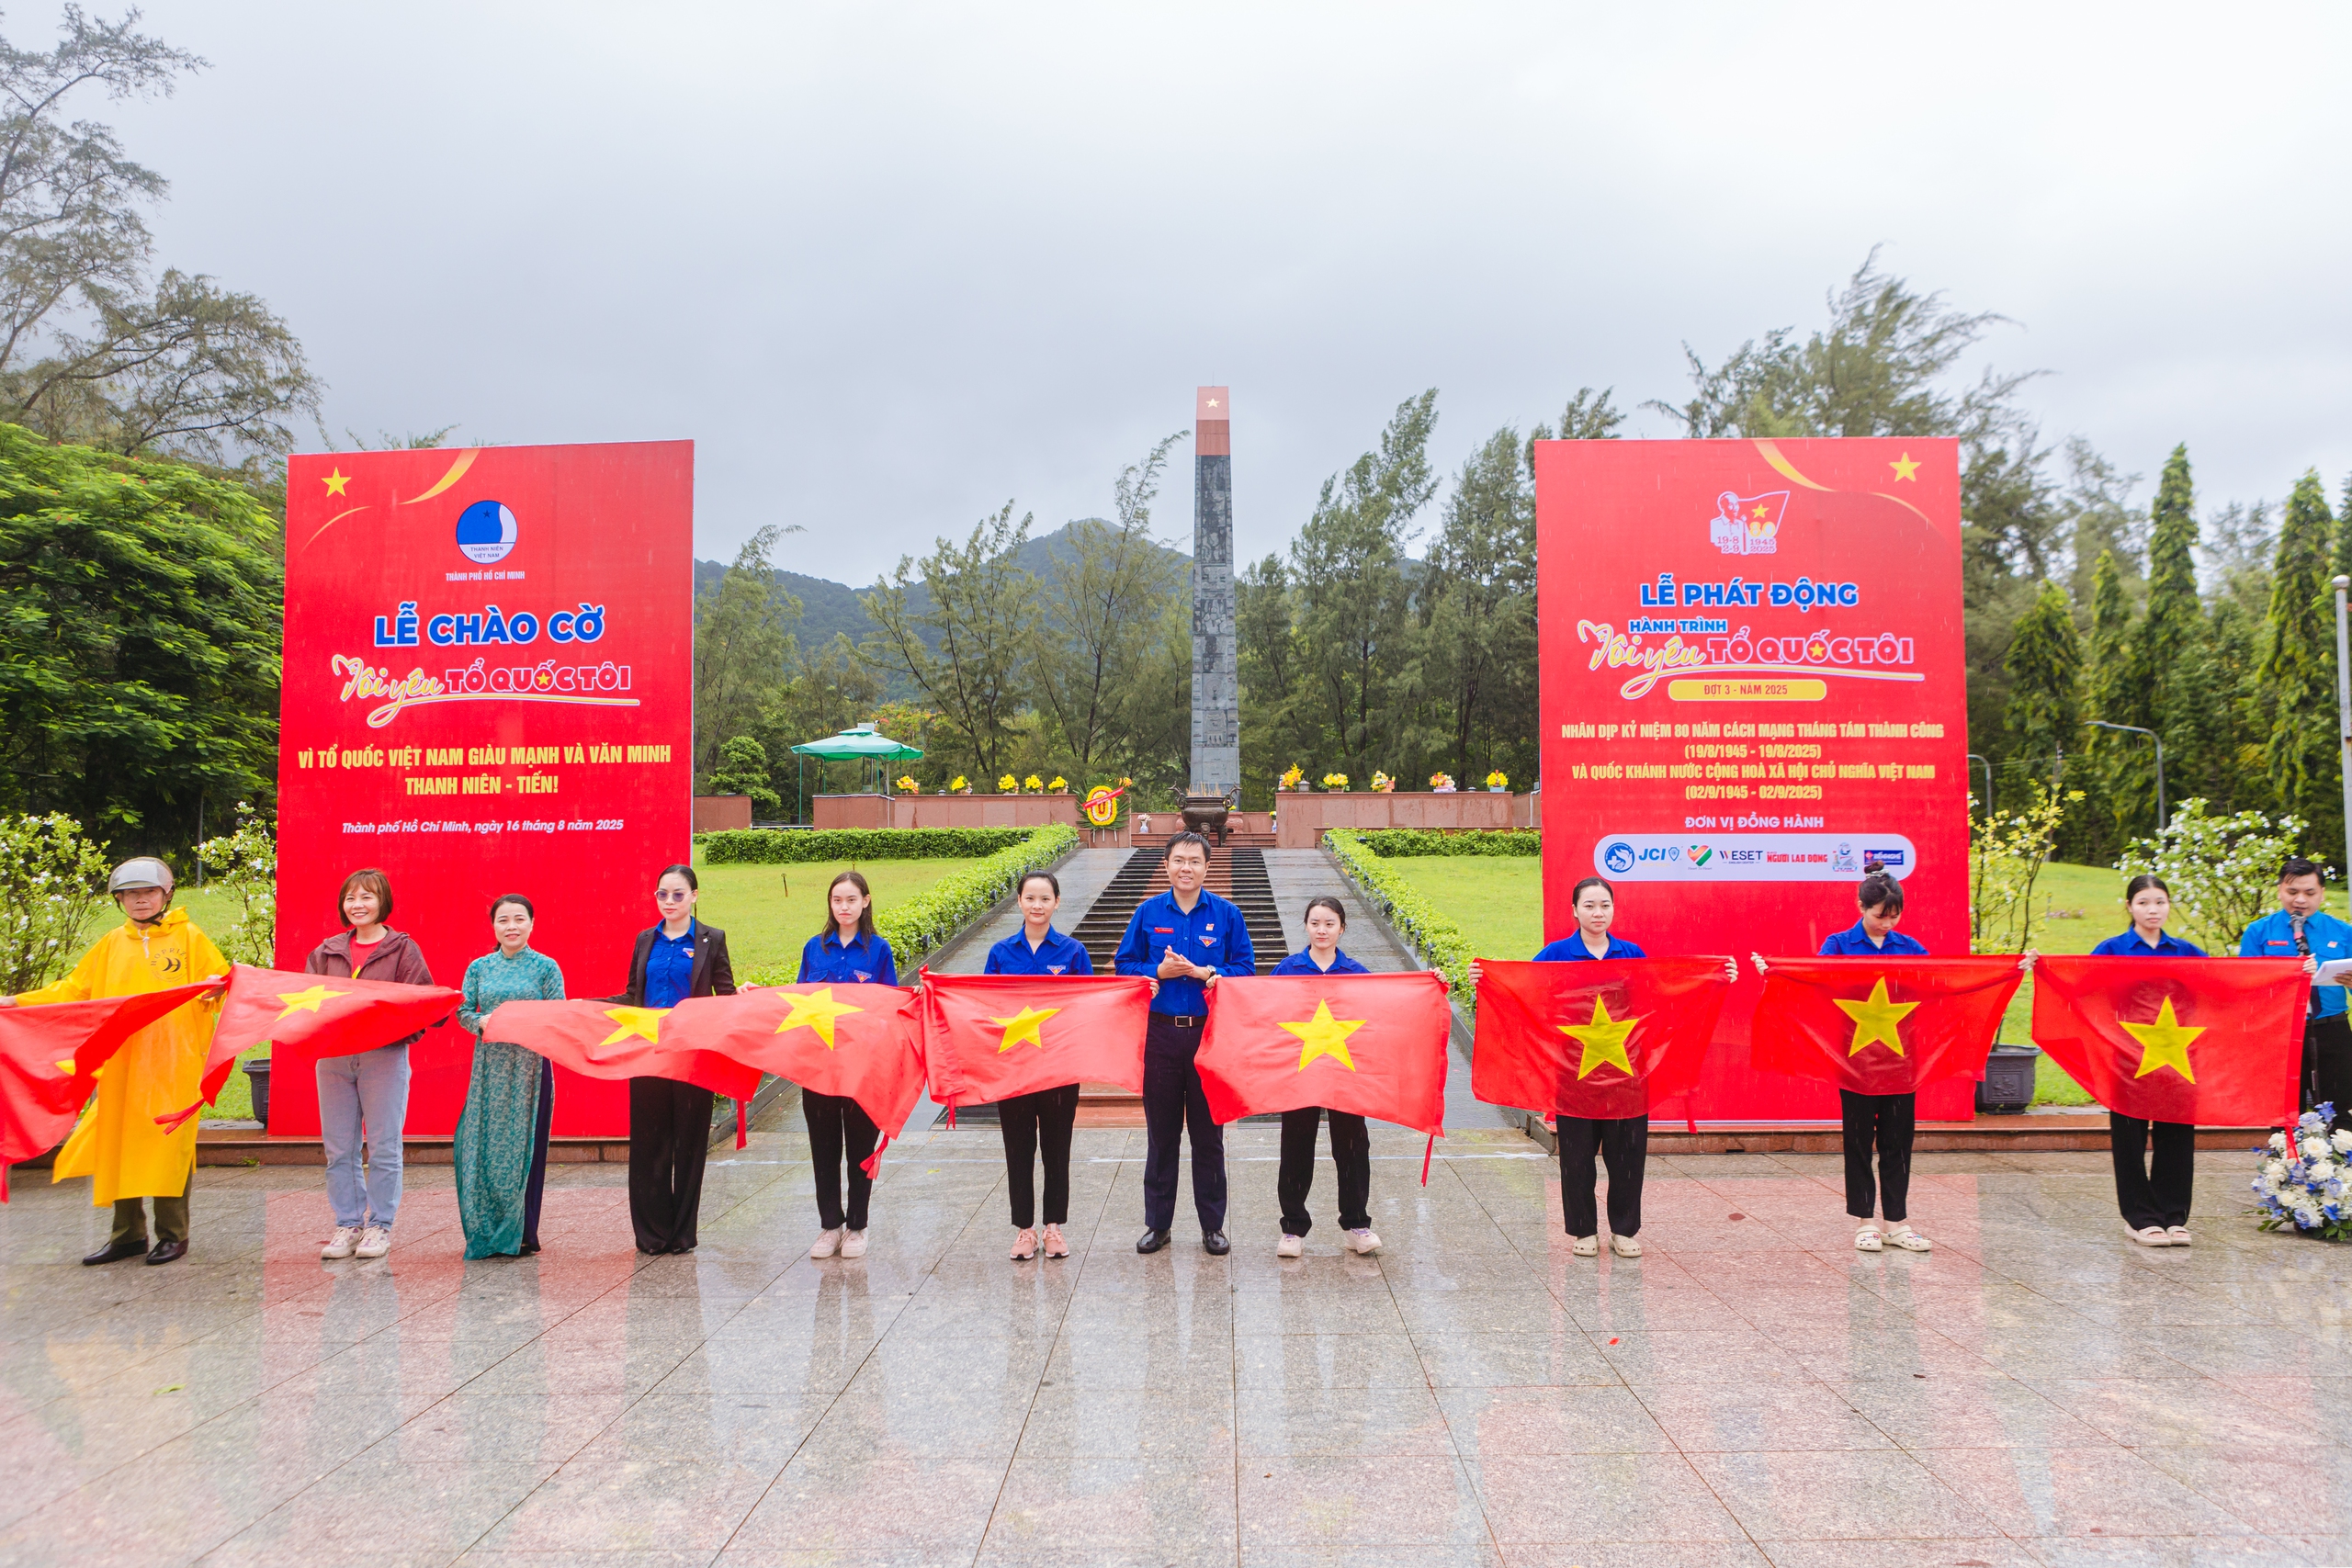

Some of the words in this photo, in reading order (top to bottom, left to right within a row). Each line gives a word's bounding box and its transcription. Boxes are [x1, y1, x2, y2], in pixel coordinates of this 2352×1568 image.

[1749, 521, 1776, 537] 80
[446, 571, 468, 581] THÀNH
[469, 570, 482, 581] PHỐ
[483, 570, 493, 581] HỒ
[494, 570, 506, 581] CHÍ
[507, 571, 526, 580] MINH
[1640, 573, 1677, 608] LỄ
[1683, 577, 1763, 607] PHÁT
[1770, 576, 1859, 611] ĐỘNG
[374, 601, 419, 647] LỄ
[427, 604, 539, 646] CHÀO
[548, 603, 605, 644] CỜ
[1628, 617, 1676, 634] HÀNH
[1679, 617, 1728, 634] TRÌNH
[1707, 626, 1752, 664] TỔ
[1757, 629, 1853, 664] QUỐC
[1855, 631, 1914, 664] TÔI
[446, 658, 486, 693] TỔ
[490, 659, 575, 692] QUỐC
[577, 660, 630, 691] TÔI
[1704, 683, 1721, 698] ĐỢT
[1724, 684, 1731, 694] 3
[1740, 681, 1761, 694] NĂM
[1765, 684, 1788, 694] 2025
[1562, 720, 1596, 738] NHÂN
[1598, 724, 1618, 741] DỊP
[1621, 718, 1636, 738] KỶ
[1639, 720, 1671, 741] NIỆM
[1674, 724, 1690, 738] 80
[1692, 720, 1721, 738] NĂM
[1723, 720, 1756, 738] CÁCH
[1758, 724, 1795, 741] MẠNG
[1797, 720, 1837, 738] THÁNG
[1839, 720, 1865, 738] TÁM
[1868, 720, 1907, 738] THÀNH
[1910, 720, 1944, 738] CÔNG
[299, 747, 313, 769] VÌ
[318, 743, 338, 768] TỔ
[341, 743, 384, 769] QUỐC
[389, 748, 421, 771] VIỆT
[426, 748, 463, 766] NAM
[468, 743, 505, 765] GIÀU
[510, 747, 559, 769] MẠNH
[564, 743, 584, 763] VÀ
[590, 741, 620, 763] VĂN
[627, 744, 671, 762] MINH
[1684, 744, 1747, 759] (19/8/1945
[1758, 744, 1822, 759] 19/8/2025)
[1572, 761, 1588, 779] VÀ
[1590, 760, 1623, 781] QUỐC
[1625, 761, 1667, 779] KHÁNH
[1669, 760, 1702, 779] NƯỚC
[1705, 761, 1740, 783] CỘNG
[1742, 761, 1766, 779] HOÀ
[1769, 761, 1785, 779] XÃ
[1788, 761, 1809, 783] HỘI
[1812, 761, 1837, 778] CHỦ
[1838, 761, 1876, 779] NGHĨA
[1879, 761, 1904, 783] VIỆT
[1905, 764, 1935, 779] NAM
[405, 777, 458, 795] THANH
[462, 773, 501, 795] NIÊN
[517, 769, 559, 794] TIẾN!
[1685, 785, 1747, 801] (02/9/1945
[1758, 785, 1822, 801] 02/9/2025)
[342, 821, 375, 833] Thành
[377, 820, 401, 835] phố
[402, 818, 418, 832] Hồ
[420, 819, 440, 832] Chí
[442, 820, 471, 834] Minh,
[473, 820, 503, 835] ngày
[506, 820, 519, 830] 16
[522, 819, 555, 835] tháng
[558, 820, 565, 829] 8
[567, 819, 593, 829] năm
[594, 819, 624, 829] 2025
[1685, 815, 1717, 829] ĐƠN
[1720, 816, 1734, 832] VỊ
[1736, 811, 1780, 829] ĐỒNG
[1782, 812, 1824, 829] HÀNH
[1638, 848, 1667, 861] JCI
[1719, 851, 1763, 861] WESET
[1792, 854, 1805, 863] LAO
